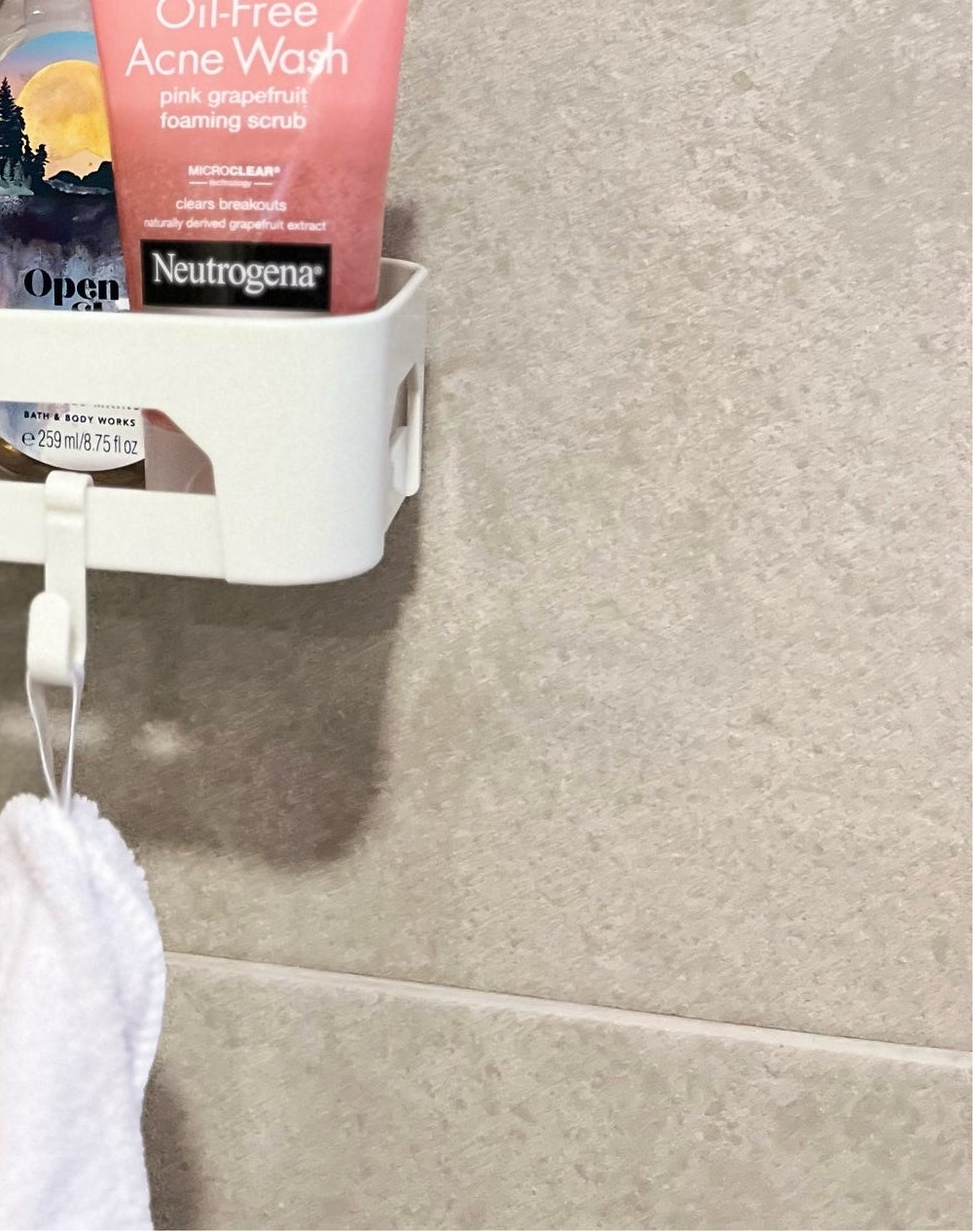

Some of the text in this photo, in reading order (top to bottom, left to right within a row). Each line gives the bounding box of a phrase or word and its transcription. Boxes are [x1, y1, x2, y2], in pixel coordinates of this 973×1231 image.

[124, 31, 349, 76] Acne Wash
[160, 86, 309, 108] pink grapefruit
[160, 111, 307, 133] foaming scrub
[208, 179, 252, 189] technology
[175, 197, 288, 213] clears breakouts
[143, 218, 327, 232] naturally derived grapefruit extract
[23, 268, 120, 306] Open
[23, 410, 137, 428] BATH & BODY WORKS
[38, 429, 62, 450] 259
[64, 430, 111, 454] ml/8.75
[113, 435, 122, 453] fl
[123, 438, 139, 455] oz
